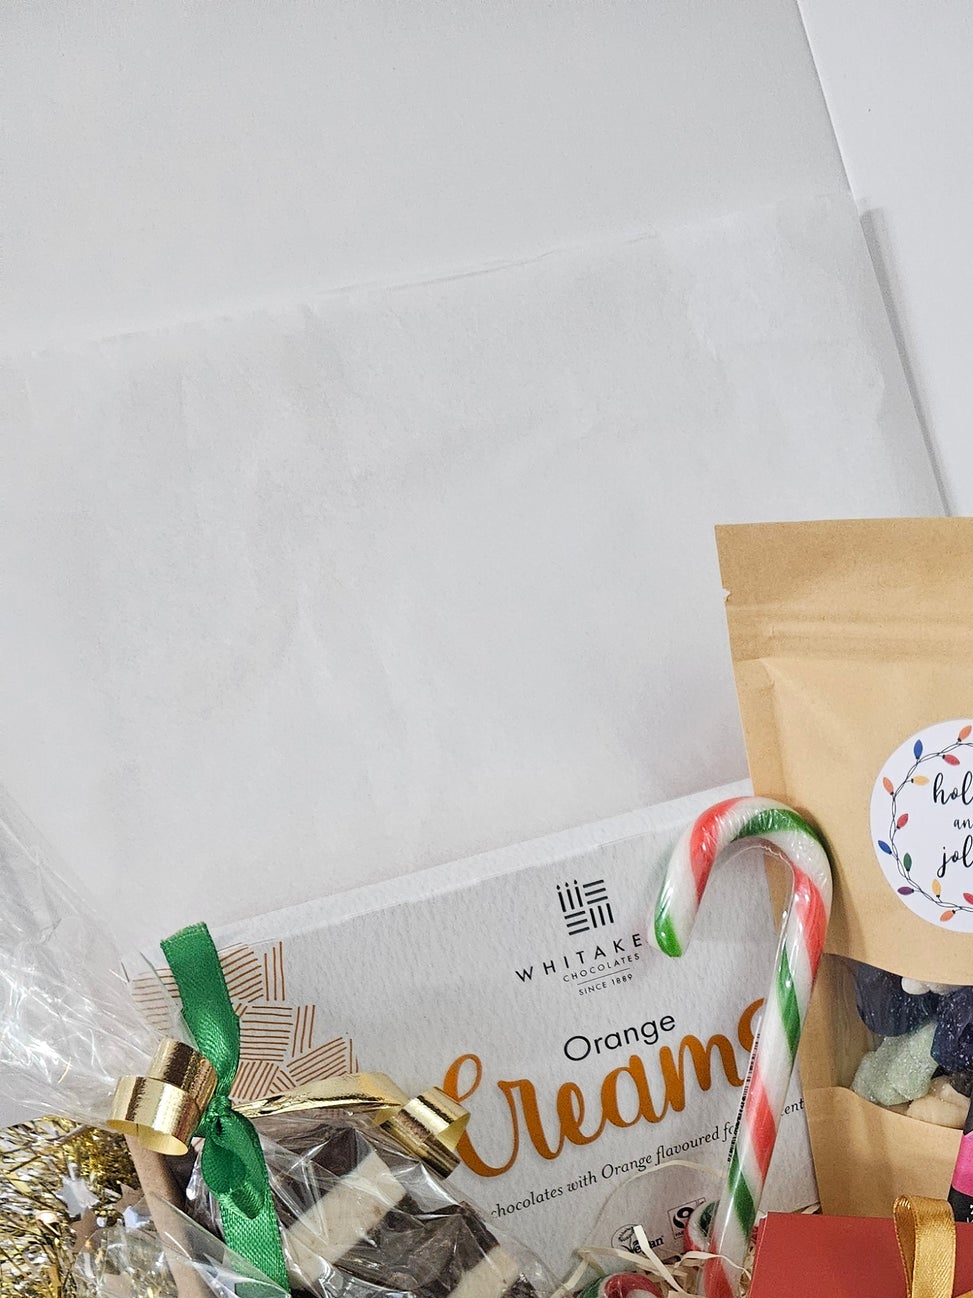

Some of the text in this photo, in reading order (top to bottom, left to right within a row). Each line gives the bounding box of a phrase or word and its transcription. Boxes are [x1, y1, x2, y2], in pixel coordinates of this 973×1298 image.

[515, 933, 642, 982] WHITAKE
[562, 952, 640, 983] CHOCOLATES
[578, 973, 633, 996] SINCE 1889
[563, 1015, 676, 1062] Orange
[567, 1168, 598, 1193] with
[601, 1153, 652, 1180] Orange
[653, 1129, 721, 1168] flavoured
